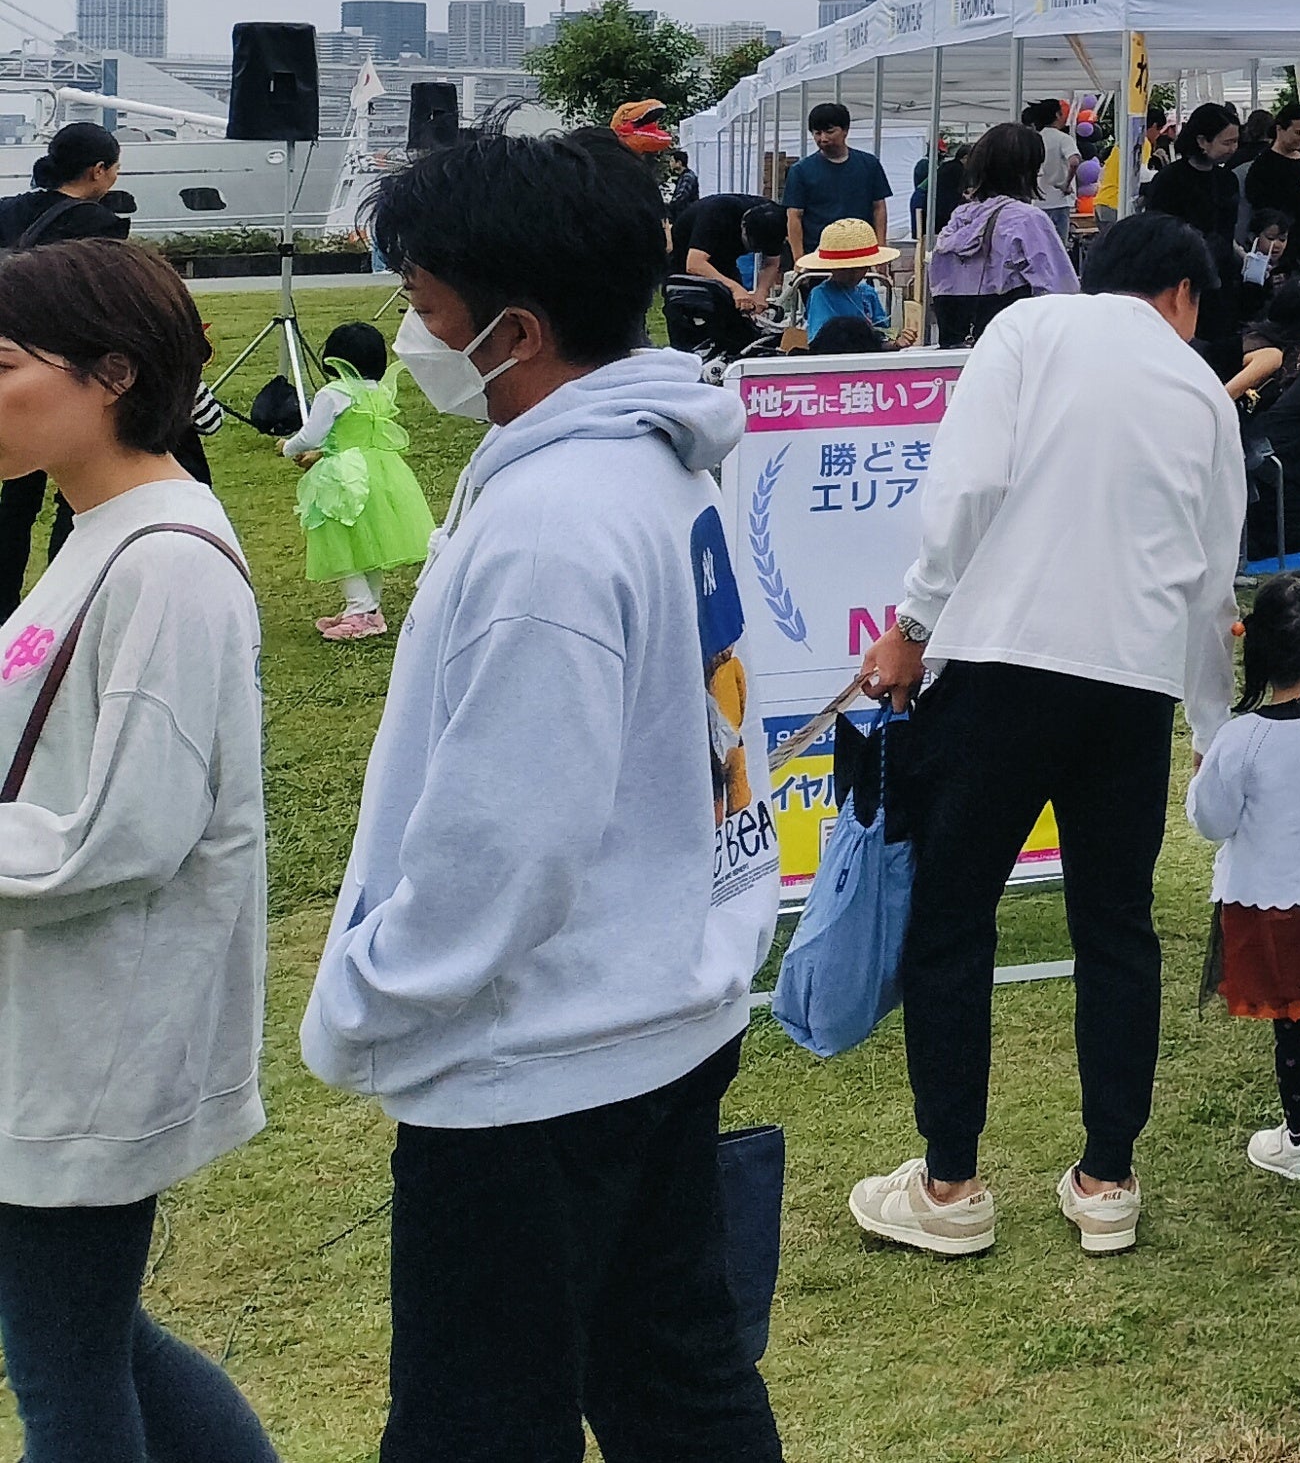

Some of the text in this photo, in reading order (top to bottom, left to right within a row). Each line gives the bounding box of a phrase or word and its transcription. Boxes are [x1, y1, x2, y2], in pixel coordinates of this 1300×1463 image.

[819, 440, 932, 477] 勝どき
[809, 477, 919, 512] エリア
